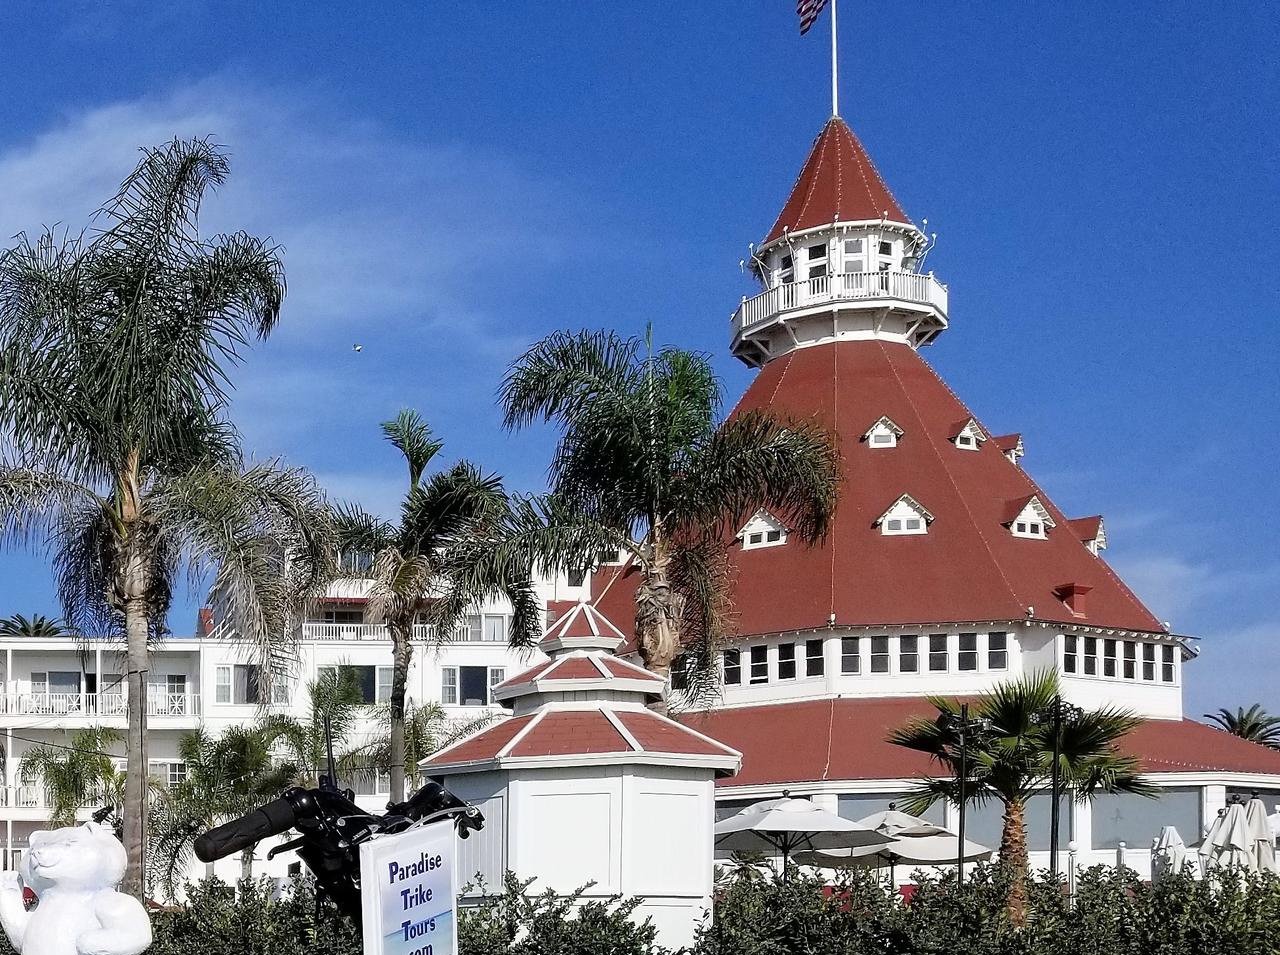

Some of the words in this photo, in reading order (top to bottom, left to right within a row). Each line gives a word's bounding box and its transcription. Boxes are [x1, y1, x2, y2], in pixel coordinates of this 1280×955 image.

[389, 852, 442, 885] Paradise
[401, 884, 433, 911] Trike
[402, 917, 436, 942] Tours
